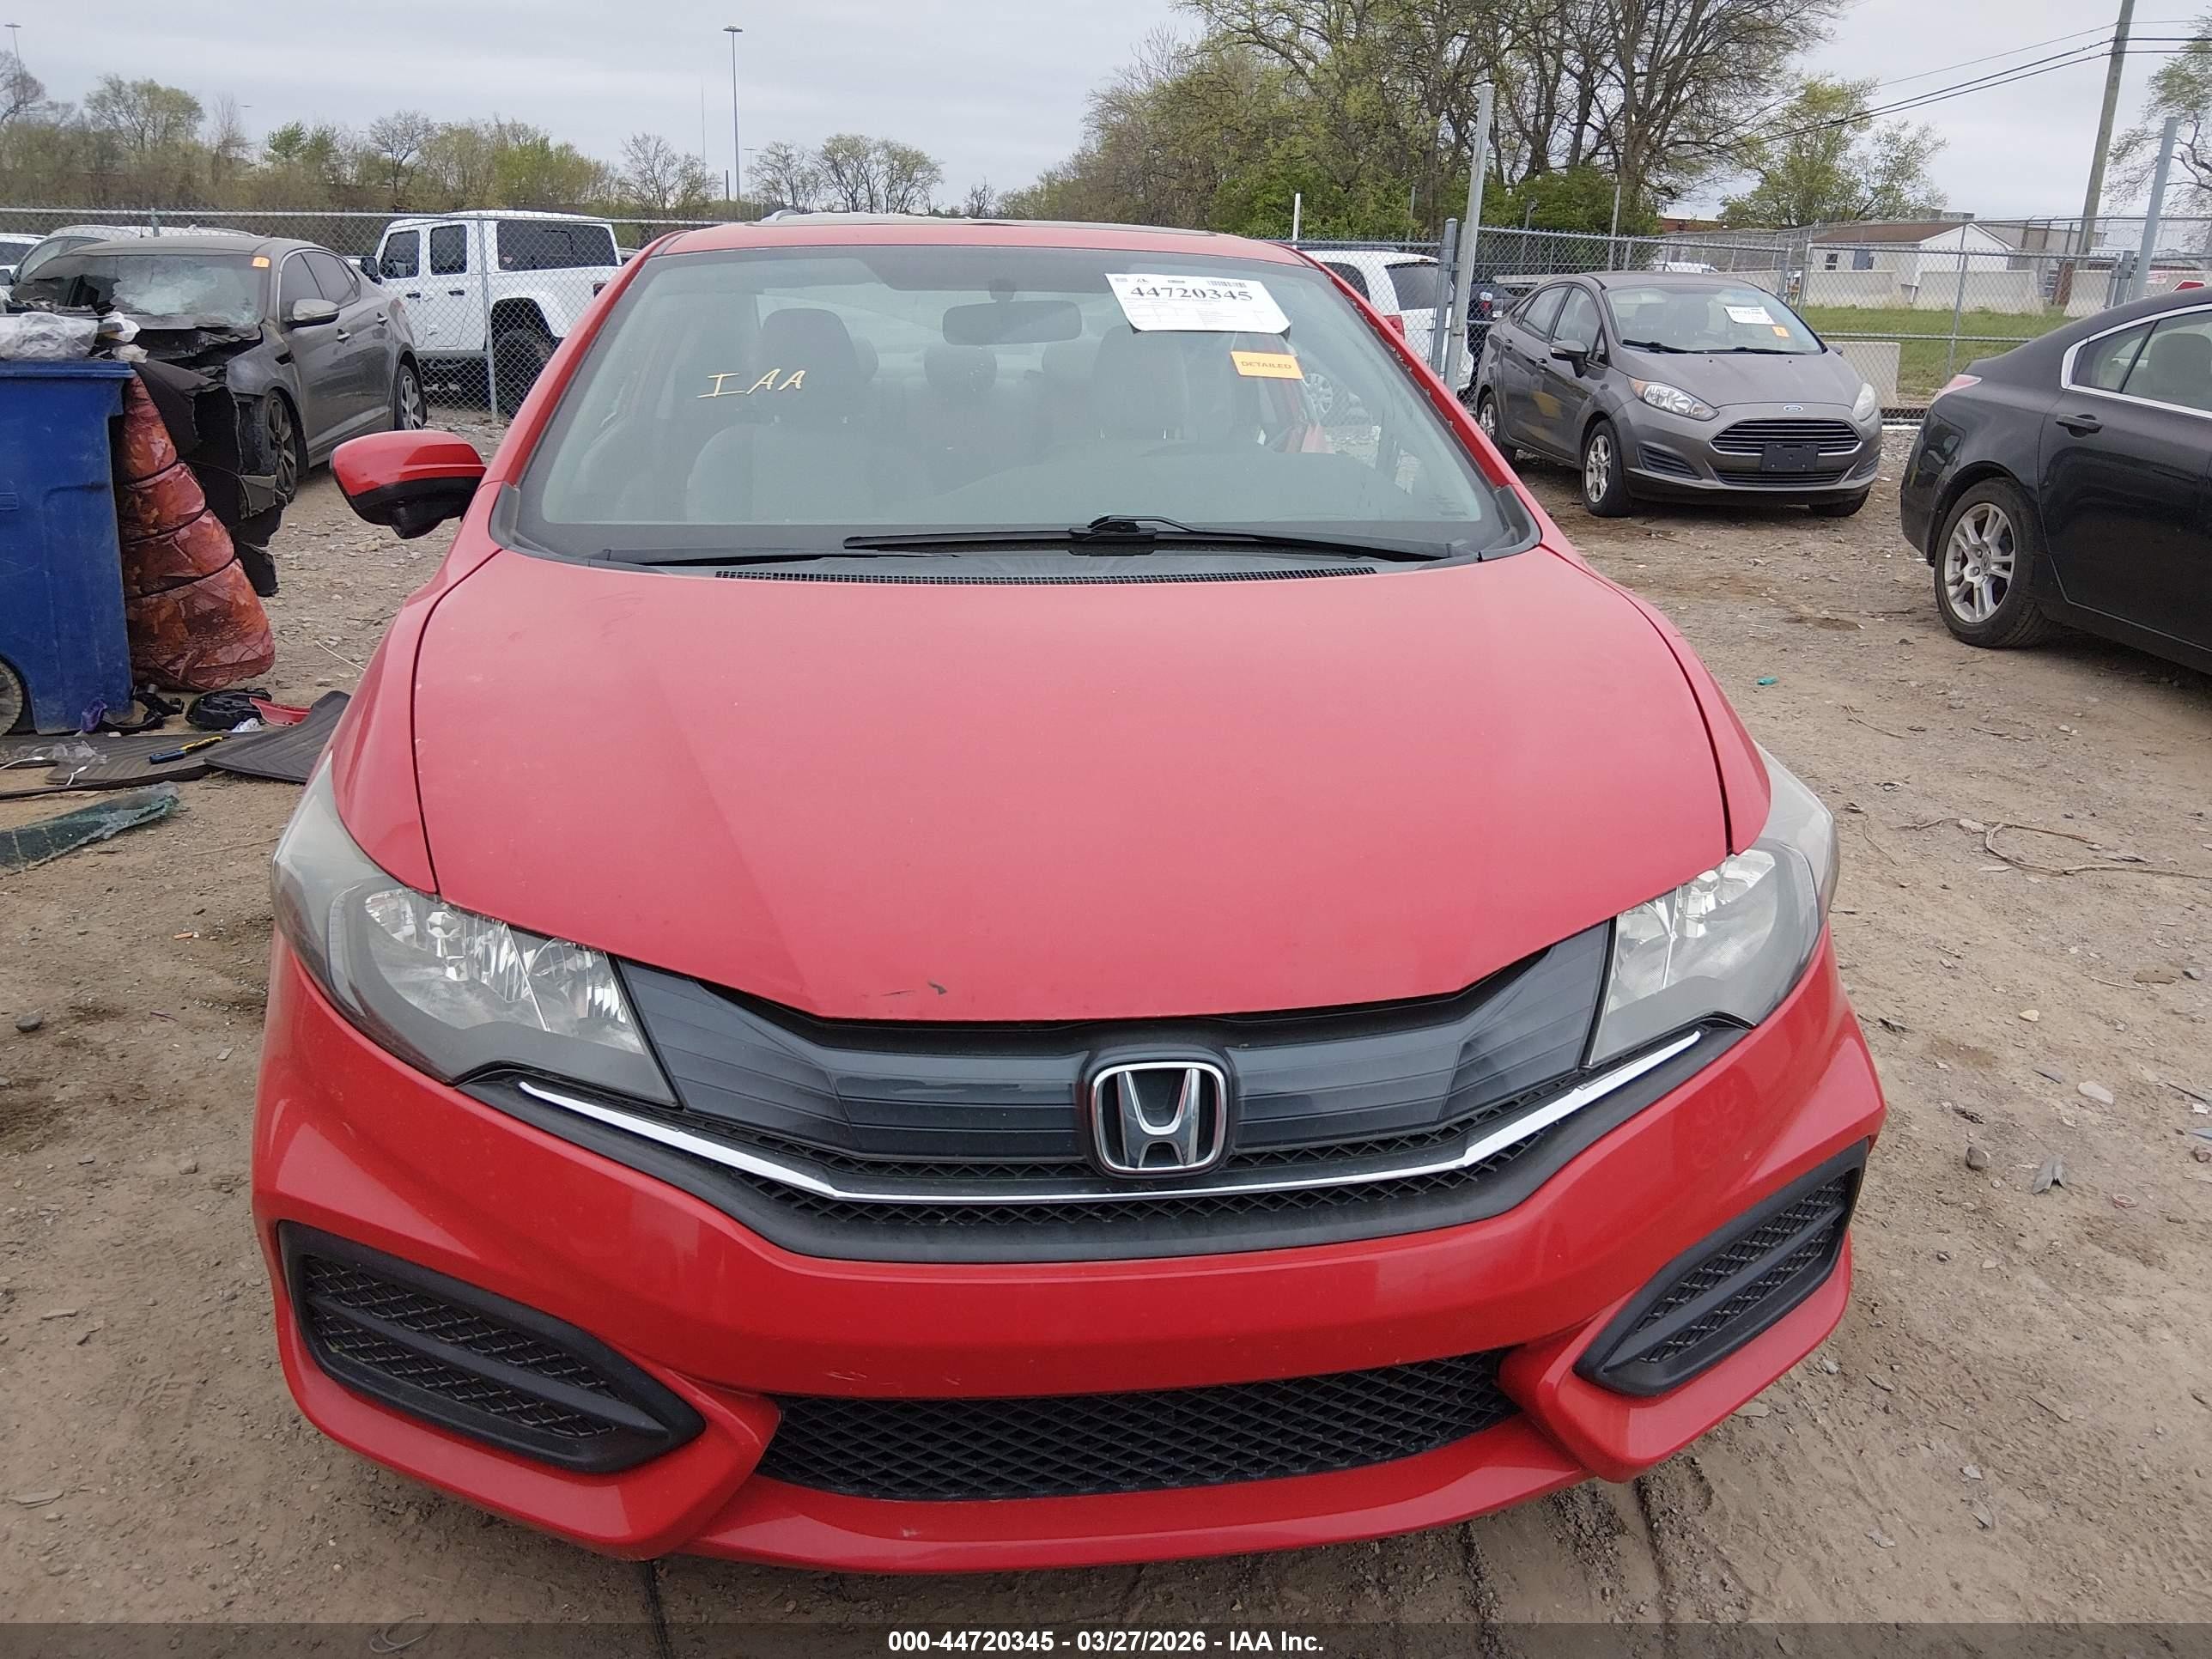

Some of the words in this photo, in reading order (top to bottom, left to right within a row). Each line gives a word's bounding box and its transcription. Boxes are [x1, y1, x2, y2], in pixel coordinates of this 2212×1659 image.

[1130, 286, 1254, 301] 44720345
[1241, 361, 1292, 369] DETAILED
[696, 368, 806, 398] IAA
